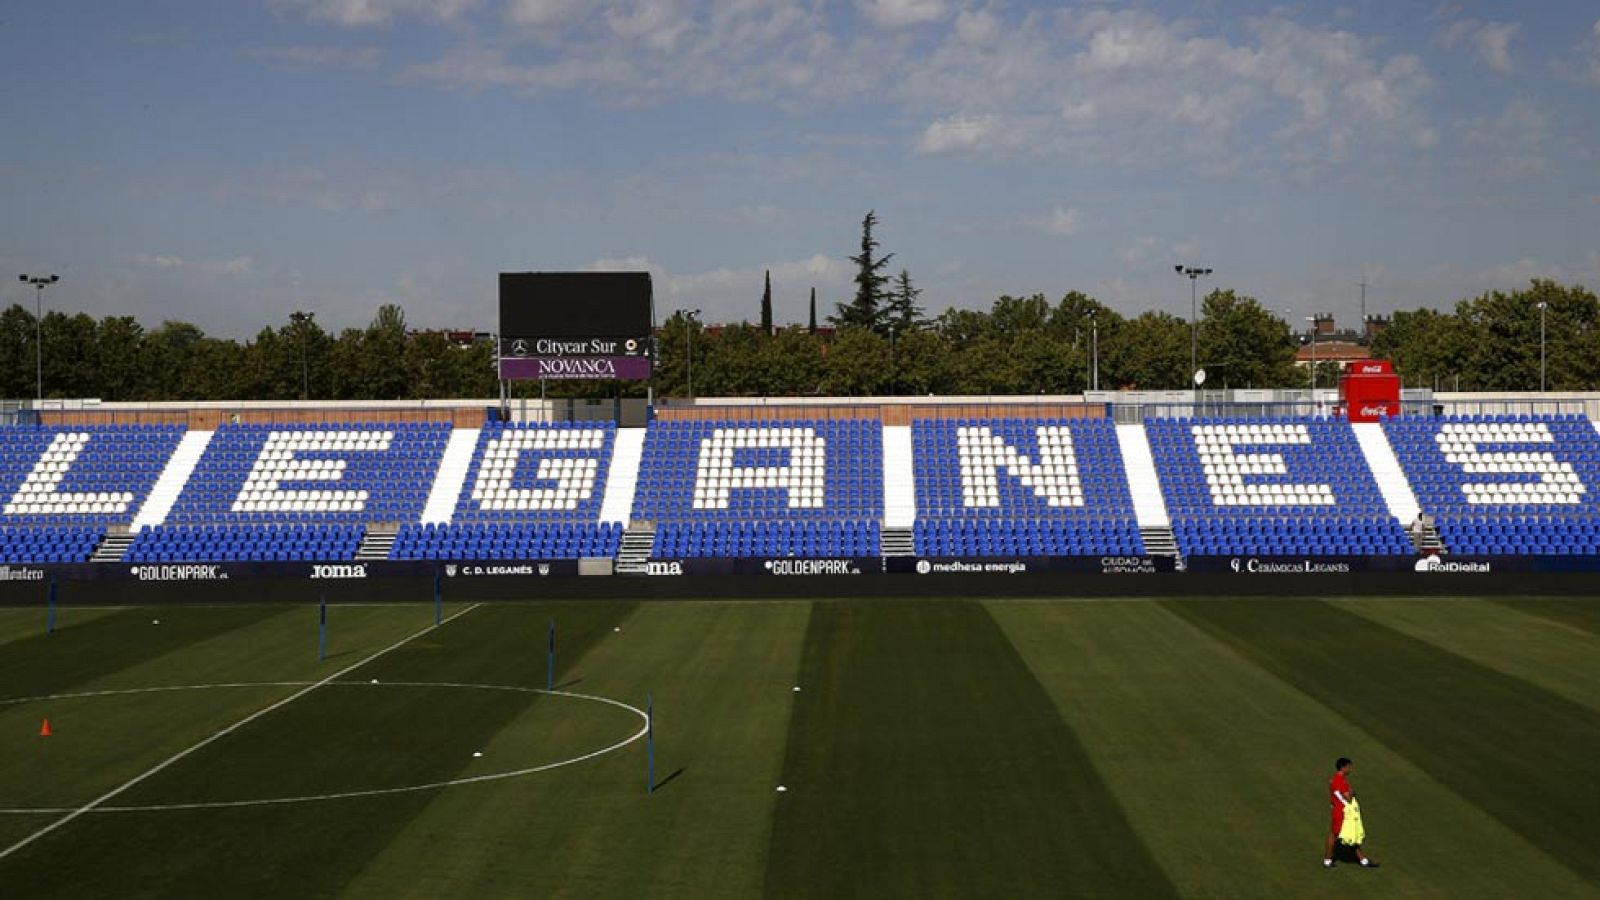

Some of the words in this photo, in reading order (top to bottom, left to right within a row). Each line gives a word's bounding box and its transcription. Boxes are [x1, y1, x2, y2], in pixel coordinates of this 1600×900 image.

[536, 339, 588, 356] Citycar
[591, 339, 617, 354] Sur
[538, 360, 615, 373] NOVANCA
[139, 565, 216, 581] GOLDENPARK
[773, 560, 850, 576] GOLDENPARK
[933, 561, 982, 571] medhesa
